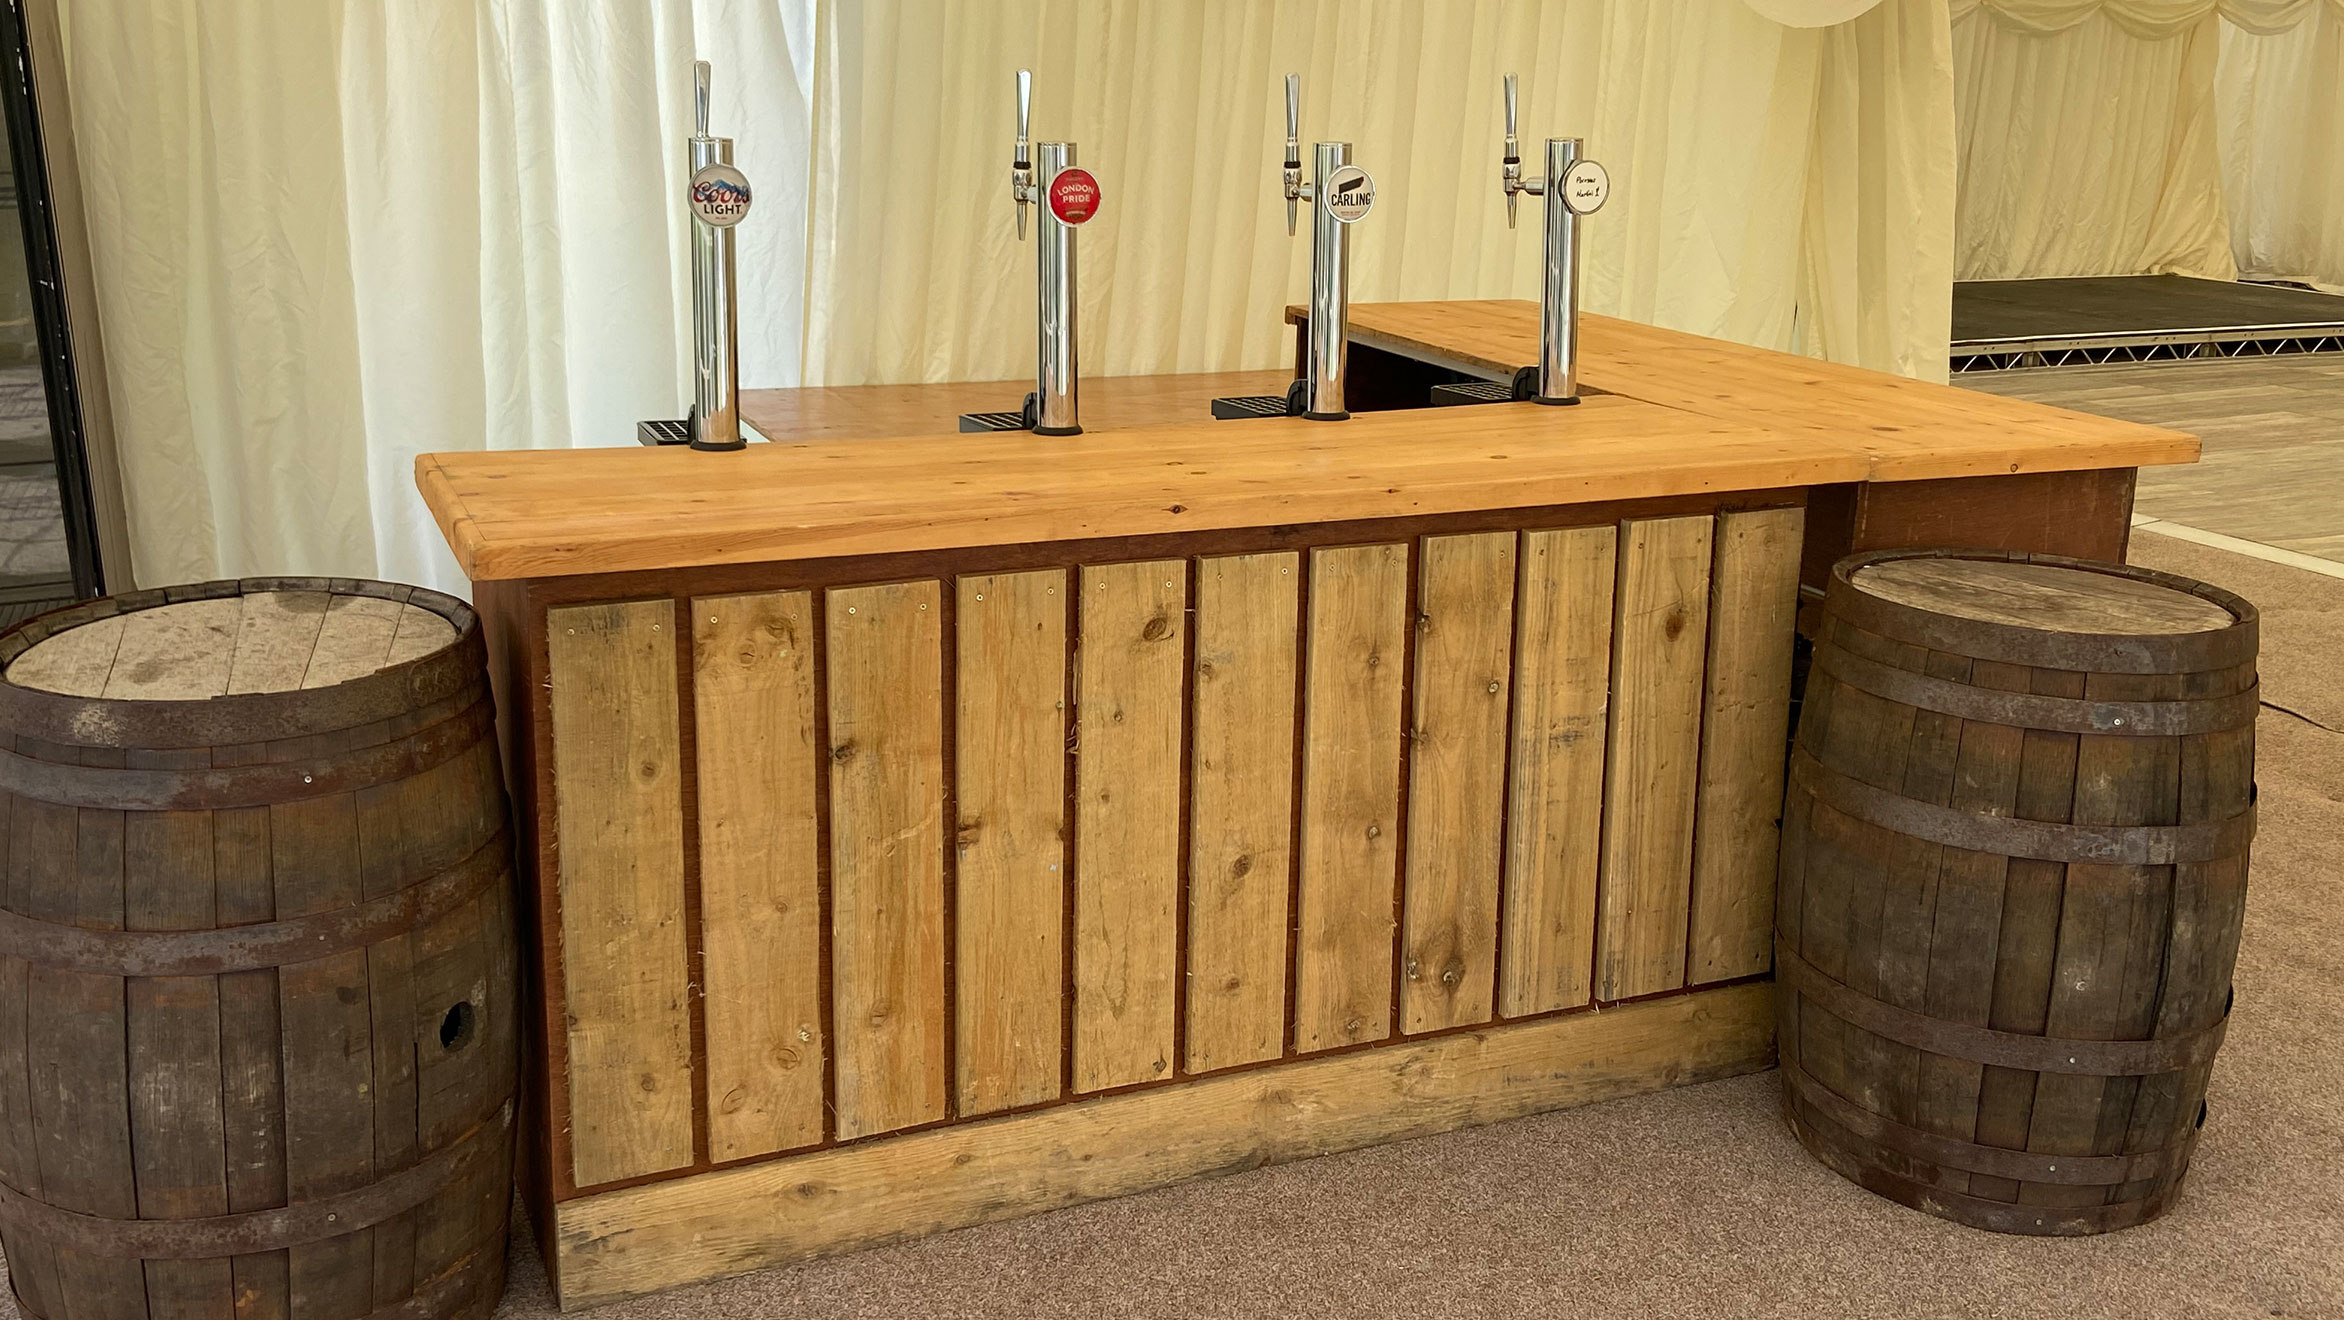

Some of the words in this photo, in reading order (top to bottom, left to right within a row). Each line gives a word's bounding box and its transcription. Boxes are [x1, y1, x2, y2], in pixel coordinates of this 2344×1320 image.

[692, 181, 750, 204] Coors
[1057, 184, 1095, 196] LONDON
[1062, 194, 1091, 203] PRIDE
[1331, 192, 1371, 207] CARLING
[703, 204, 741, 215] LIGHT
